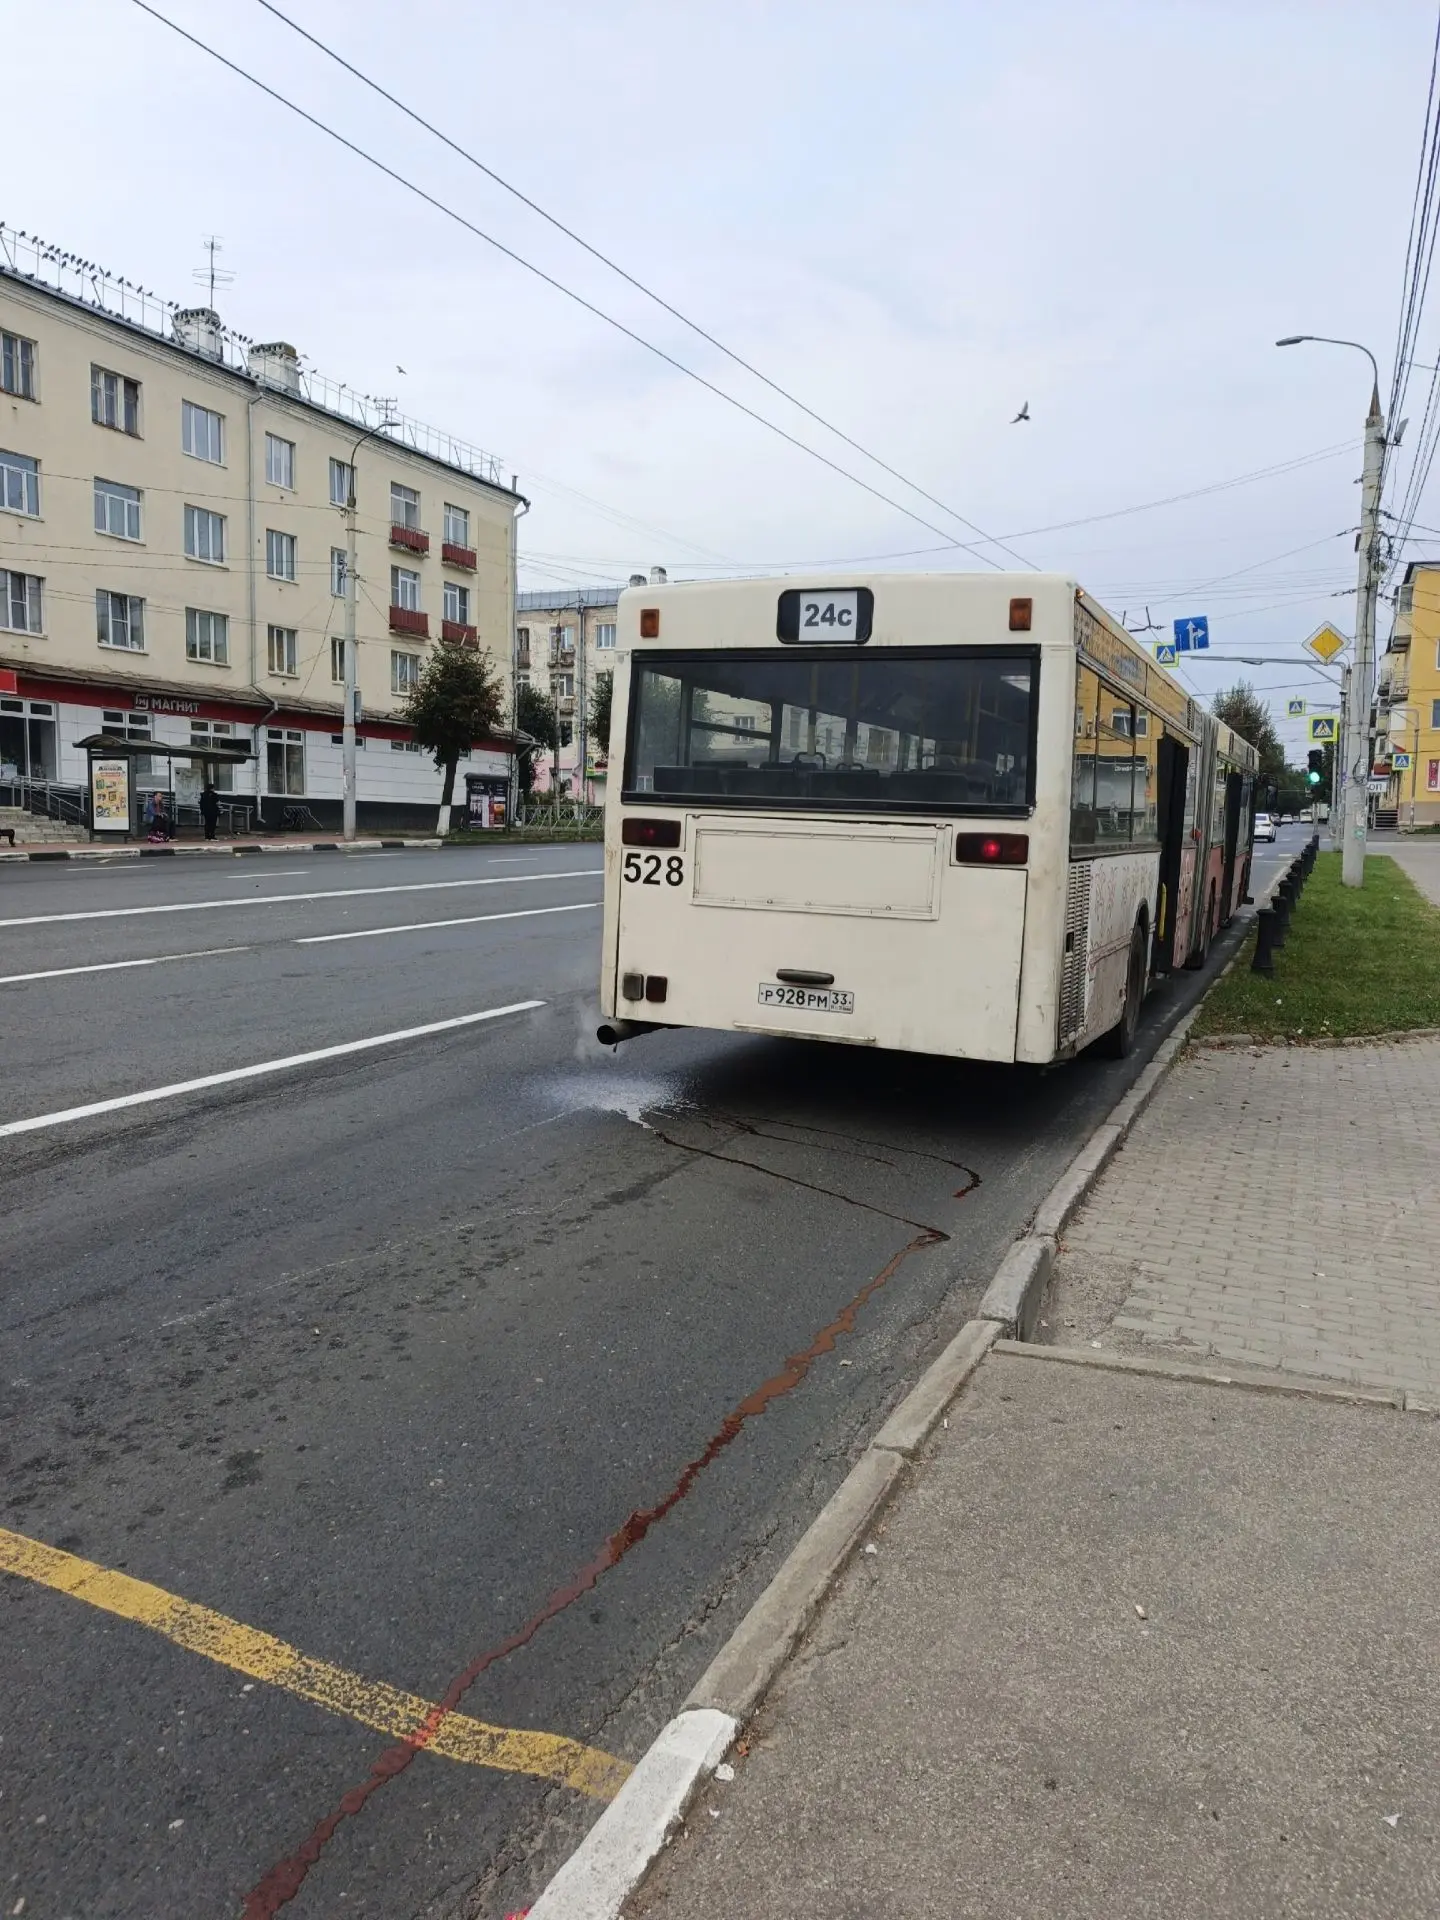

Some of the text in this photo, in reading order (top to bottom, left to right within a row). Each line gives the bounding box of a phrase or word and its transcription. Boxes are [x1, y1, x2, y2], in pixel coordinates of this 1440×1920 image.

[804, 602, 852, 627] 24с
[151, 697, 200, 713] МАГНИТ
[623, 852, 684, 887] 528
[832, 992, 847, 1005] 33
